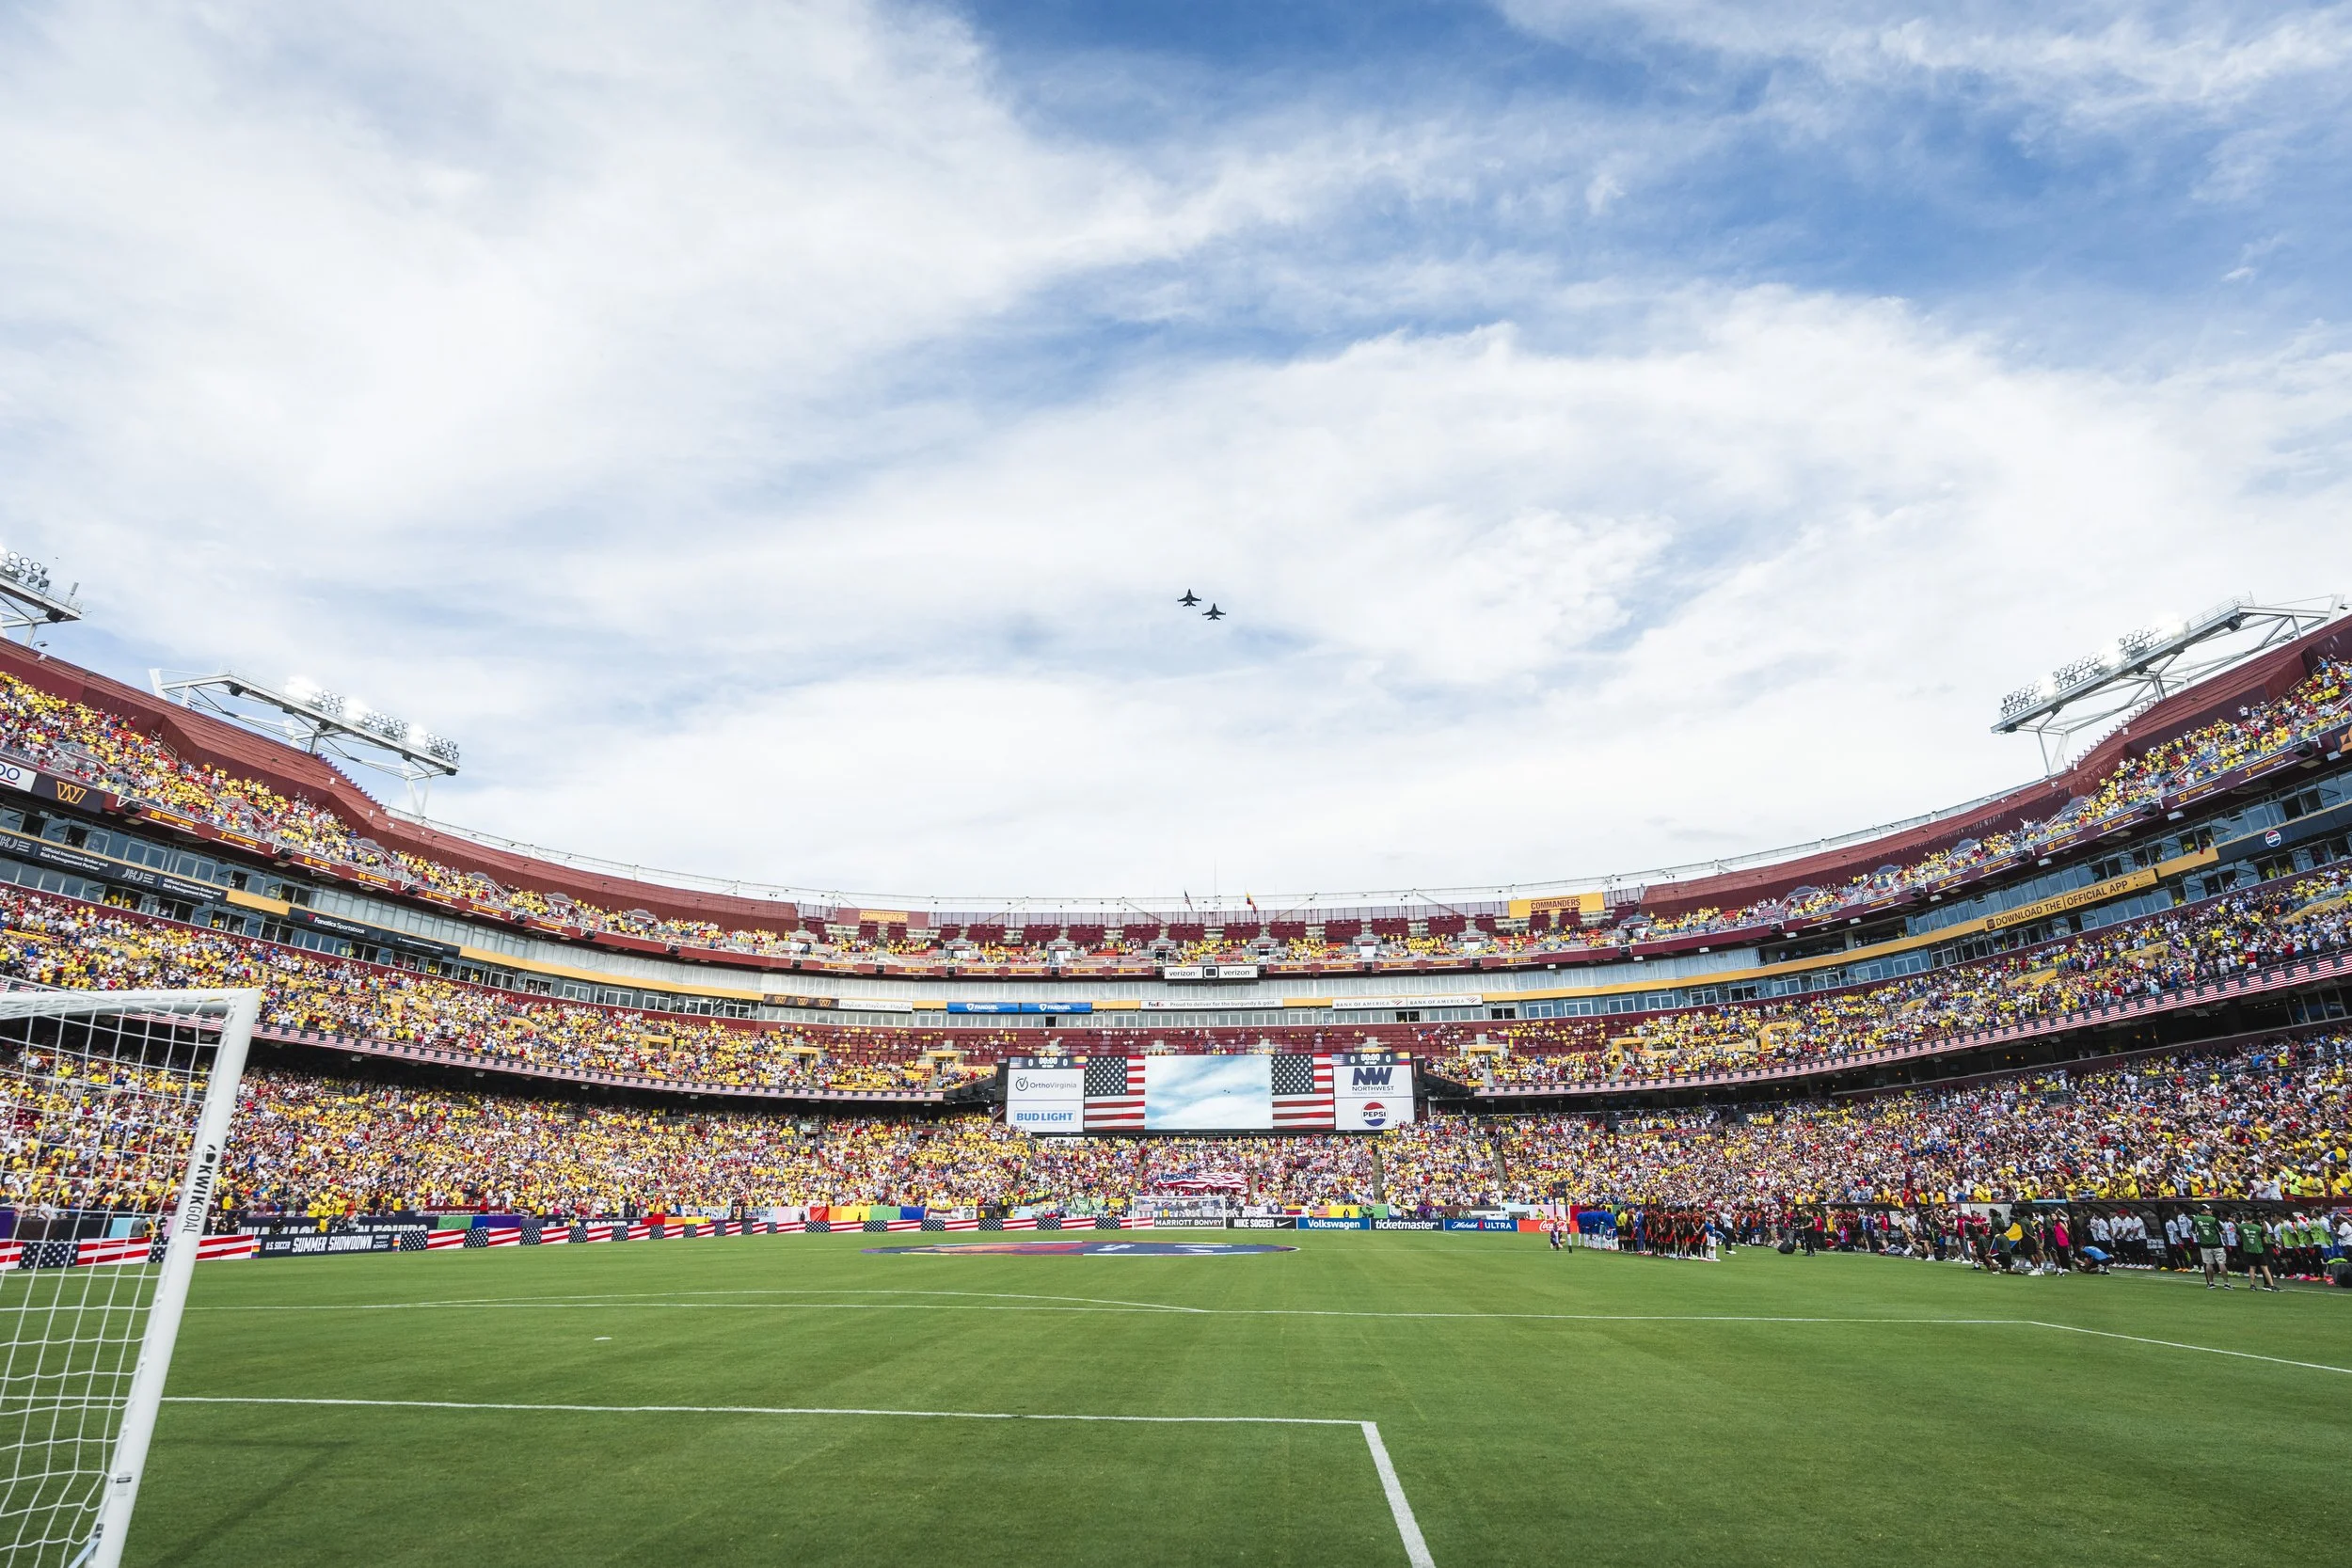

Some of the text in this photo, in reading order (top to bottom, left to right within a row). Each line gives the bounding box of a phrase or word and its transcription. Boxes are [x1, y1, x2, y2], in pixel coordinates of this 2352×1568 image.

[2245, 768, 2252, 777] 3
[2178, 792, 2187, 802] 57
[42, 846, 61, 855] Official
[61, 851, 83, 861] Insurance
[84, 857, 99, 865] Broker
[51, 855, 82, 867] Management
[82, 862, 100, 871] Partner
[172, 885, 199, 896] Management
[180, 882, 200, 891] Insurance
[1531, 898, 1581, 910] COMMANDERS
[1996, 880, 2128, 926] DOWNLOAD THE OFFICIAL APP
[860, 912, 908, 922] COMMANDERS
[314, 917, 365, 934] Fanatics Sportsbook
[1352, 1067, 1393, 1085] NW
[1234, 1219, 1274, 1228] NIKE SOCCER
[1308, 1220, 1360, 1230] Volkswagen
[274, 1241, 291, 1250] SOCCER
[292, 1237, 327, 1253] SUMMER
[328, 1235, 373, 1251] SHOWDOWN
